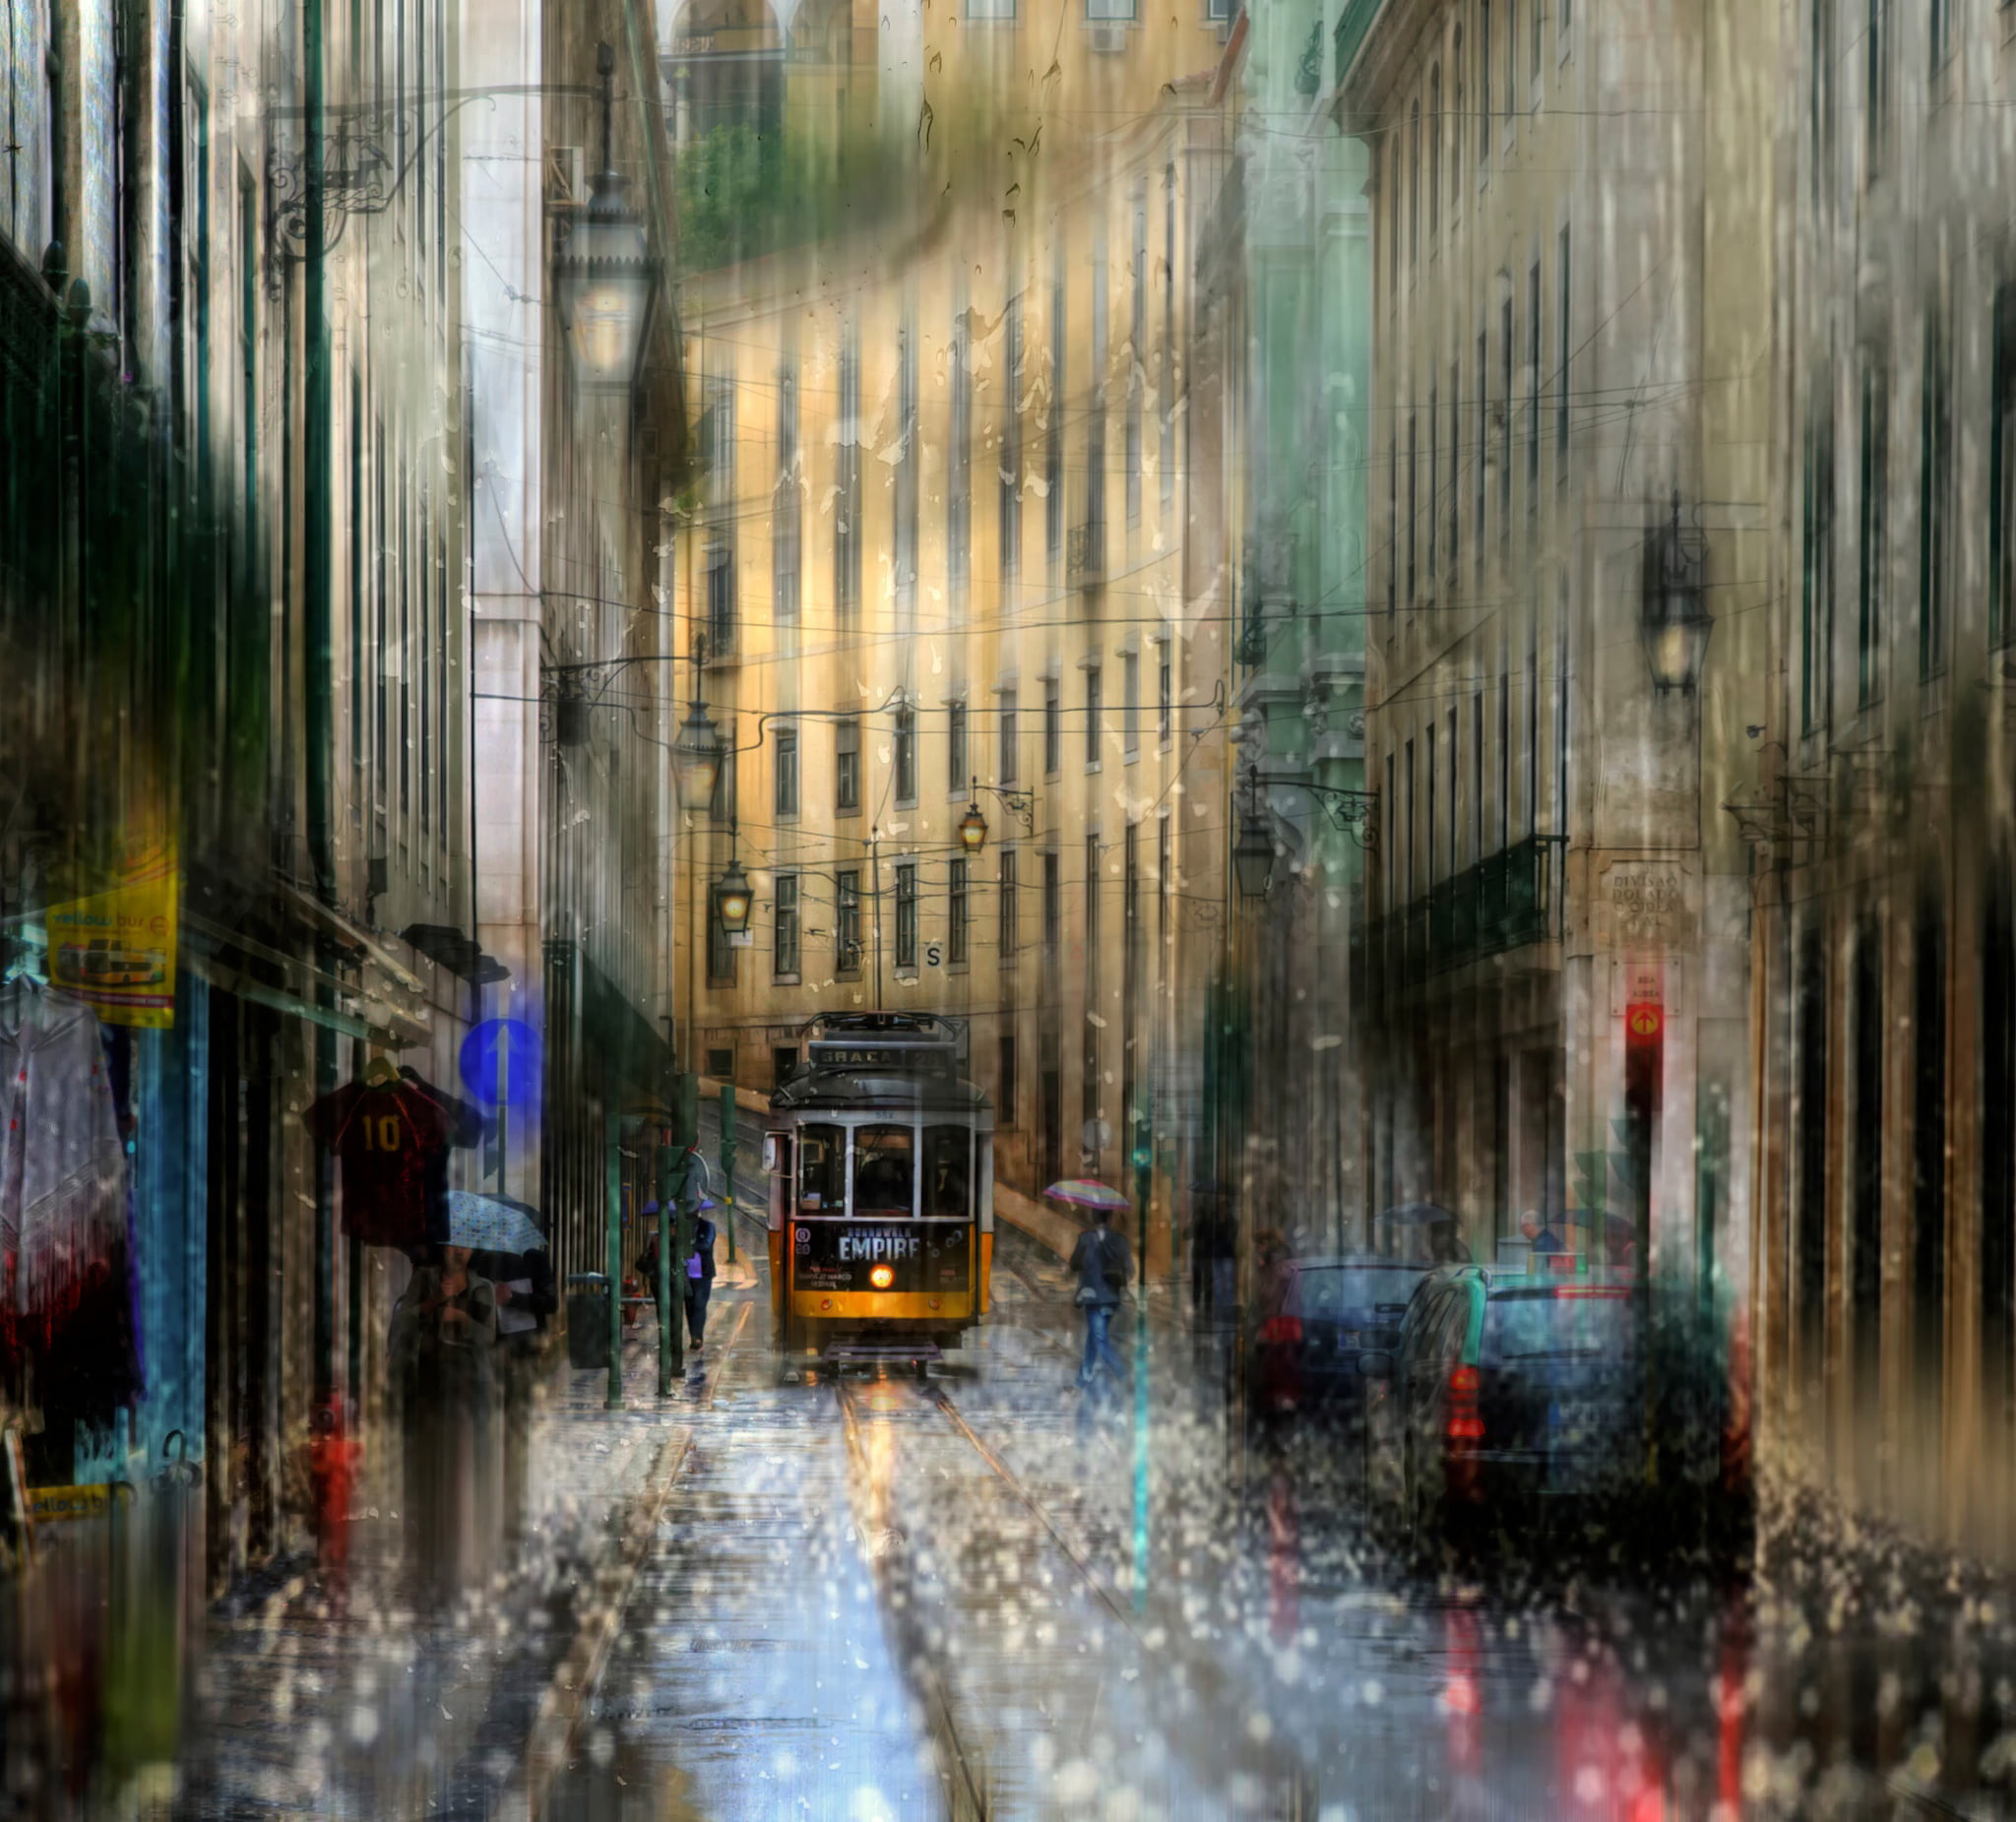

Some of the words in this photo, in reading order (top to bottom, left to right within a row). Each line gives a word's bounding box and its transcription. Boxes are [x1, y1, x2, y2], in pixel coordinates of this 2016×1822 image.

[116, 912, 145, 927] bus
[926, 947, 941, 968] S
[362, 1115, 401, 1151] 10
[848, 1227, 912, 1237] BOARDWALK
[839, 1237, 920, 1260] EMPIRE
